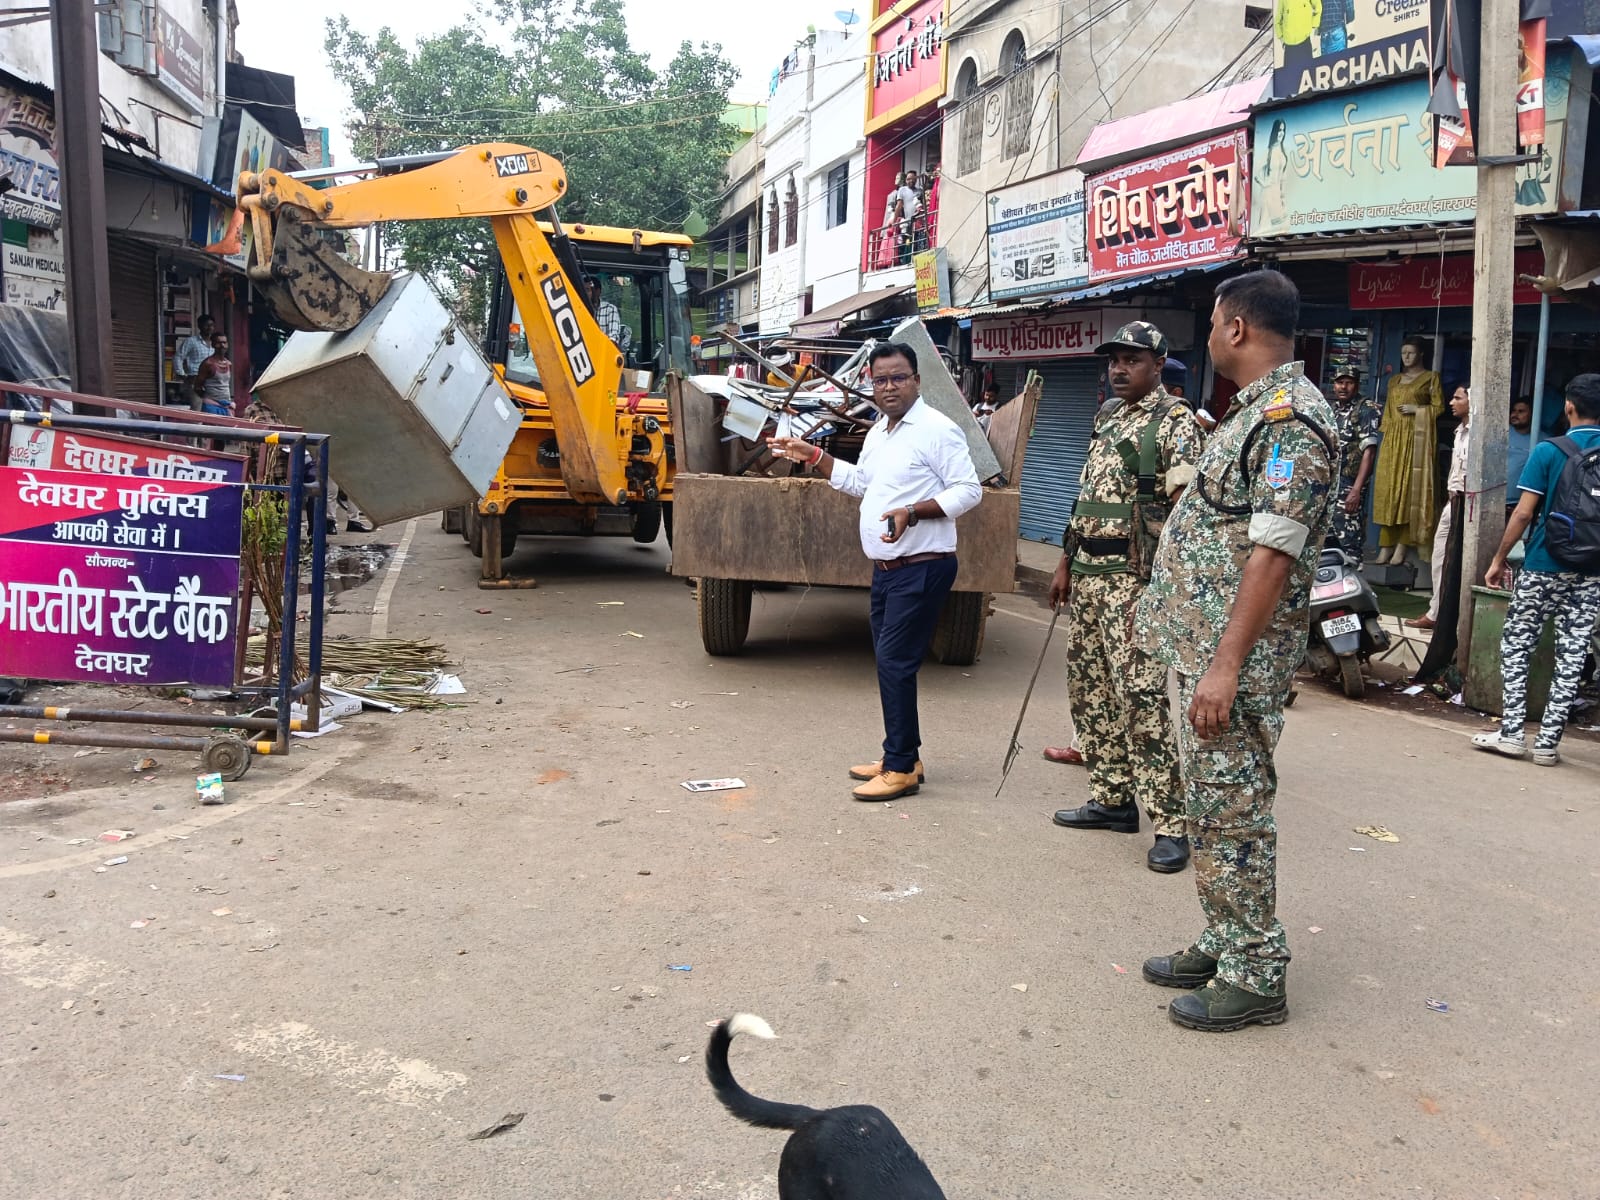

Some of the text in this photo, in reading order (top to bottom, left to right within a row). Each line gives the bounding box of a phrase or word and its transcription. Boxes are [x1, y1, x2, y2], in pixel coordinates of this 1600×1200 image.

[1394, 8, 1420, 22] SHIRTS
[1298, 38, 1430, 95] ARCHANA
[1290, 103, 1410, 182] अर्चना
[1093, 179, 1151, 241] शिव
[9, 252, 34, 269] SANJAY
[36, 257, 61, 274] MEDICAL
[1151, 240, 1190, 262] जसीडीह
[1190, 237, 1216, 256] बाजार
[1358, 270, 1397, 301] Lyra
[1420, 266, 1461, 299] Lyra
[544, 280, 593, 386] JCB
[64, 436, 228, 482] देवघर पलिस
[17, 471, 209, 520] देवघर पुलिस
[52, 519, 109, 544] आपकी
[113, 520, 147, 546] सेवा
[151, 523, 166, 548] में
[0, 568, 106, 638] भारतीय
[109, 576, 171, 640] स्टेट
[74, 644, 151, 676] देवघर
